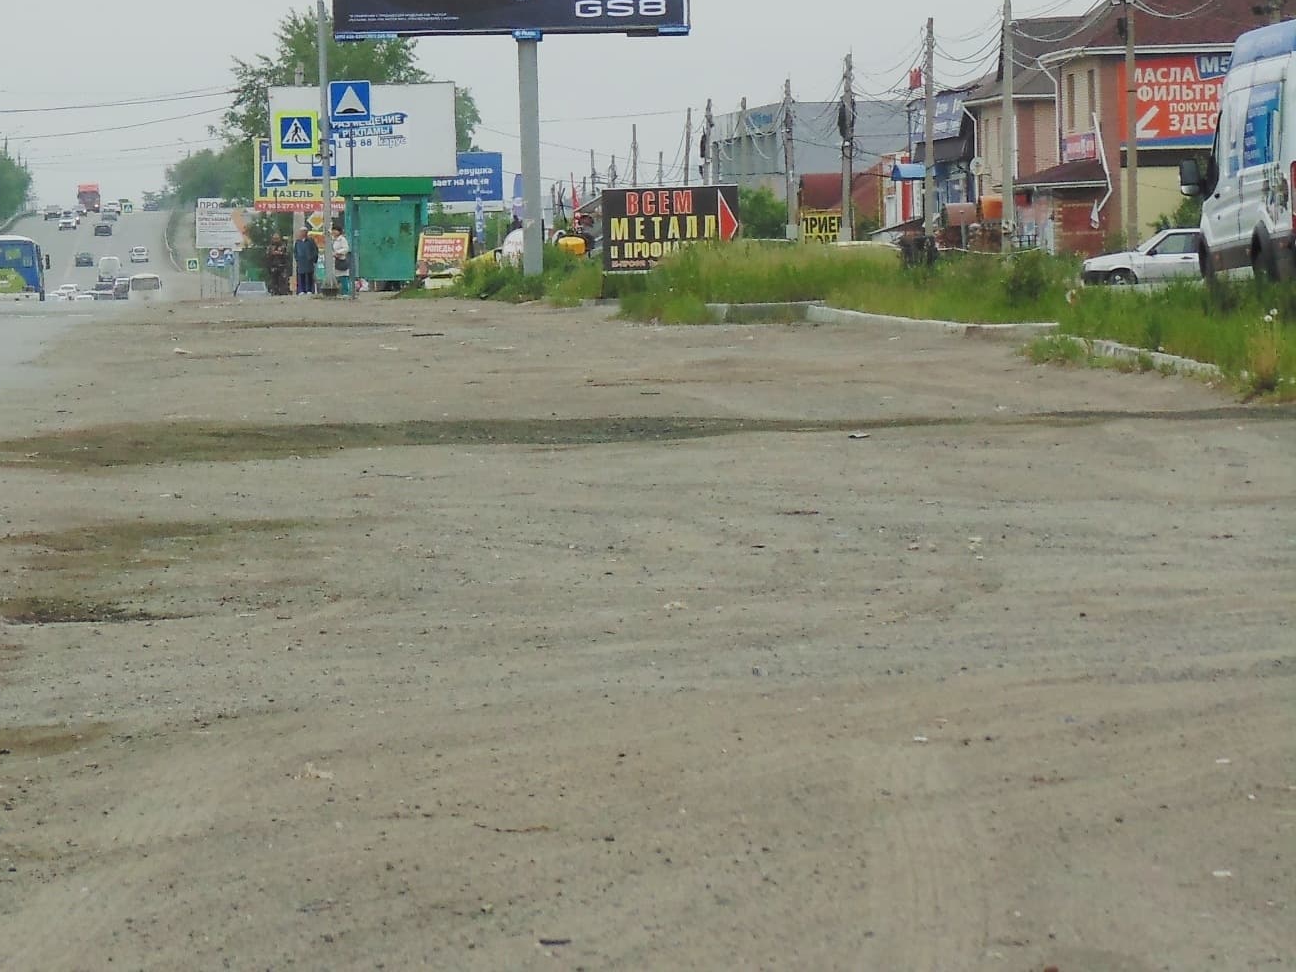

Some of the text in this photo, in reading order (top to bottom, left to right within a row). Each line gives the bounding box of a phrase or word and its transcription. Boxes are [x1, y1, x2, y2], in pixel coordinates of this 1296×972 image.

[575, 0, 666, 17] GS8
[1169, 102, 1220, 113] ПОКУПА
[626, 190, 693, 216] ВСЕМ
[610, 215, 715, 241] МЕТАЛЛ
